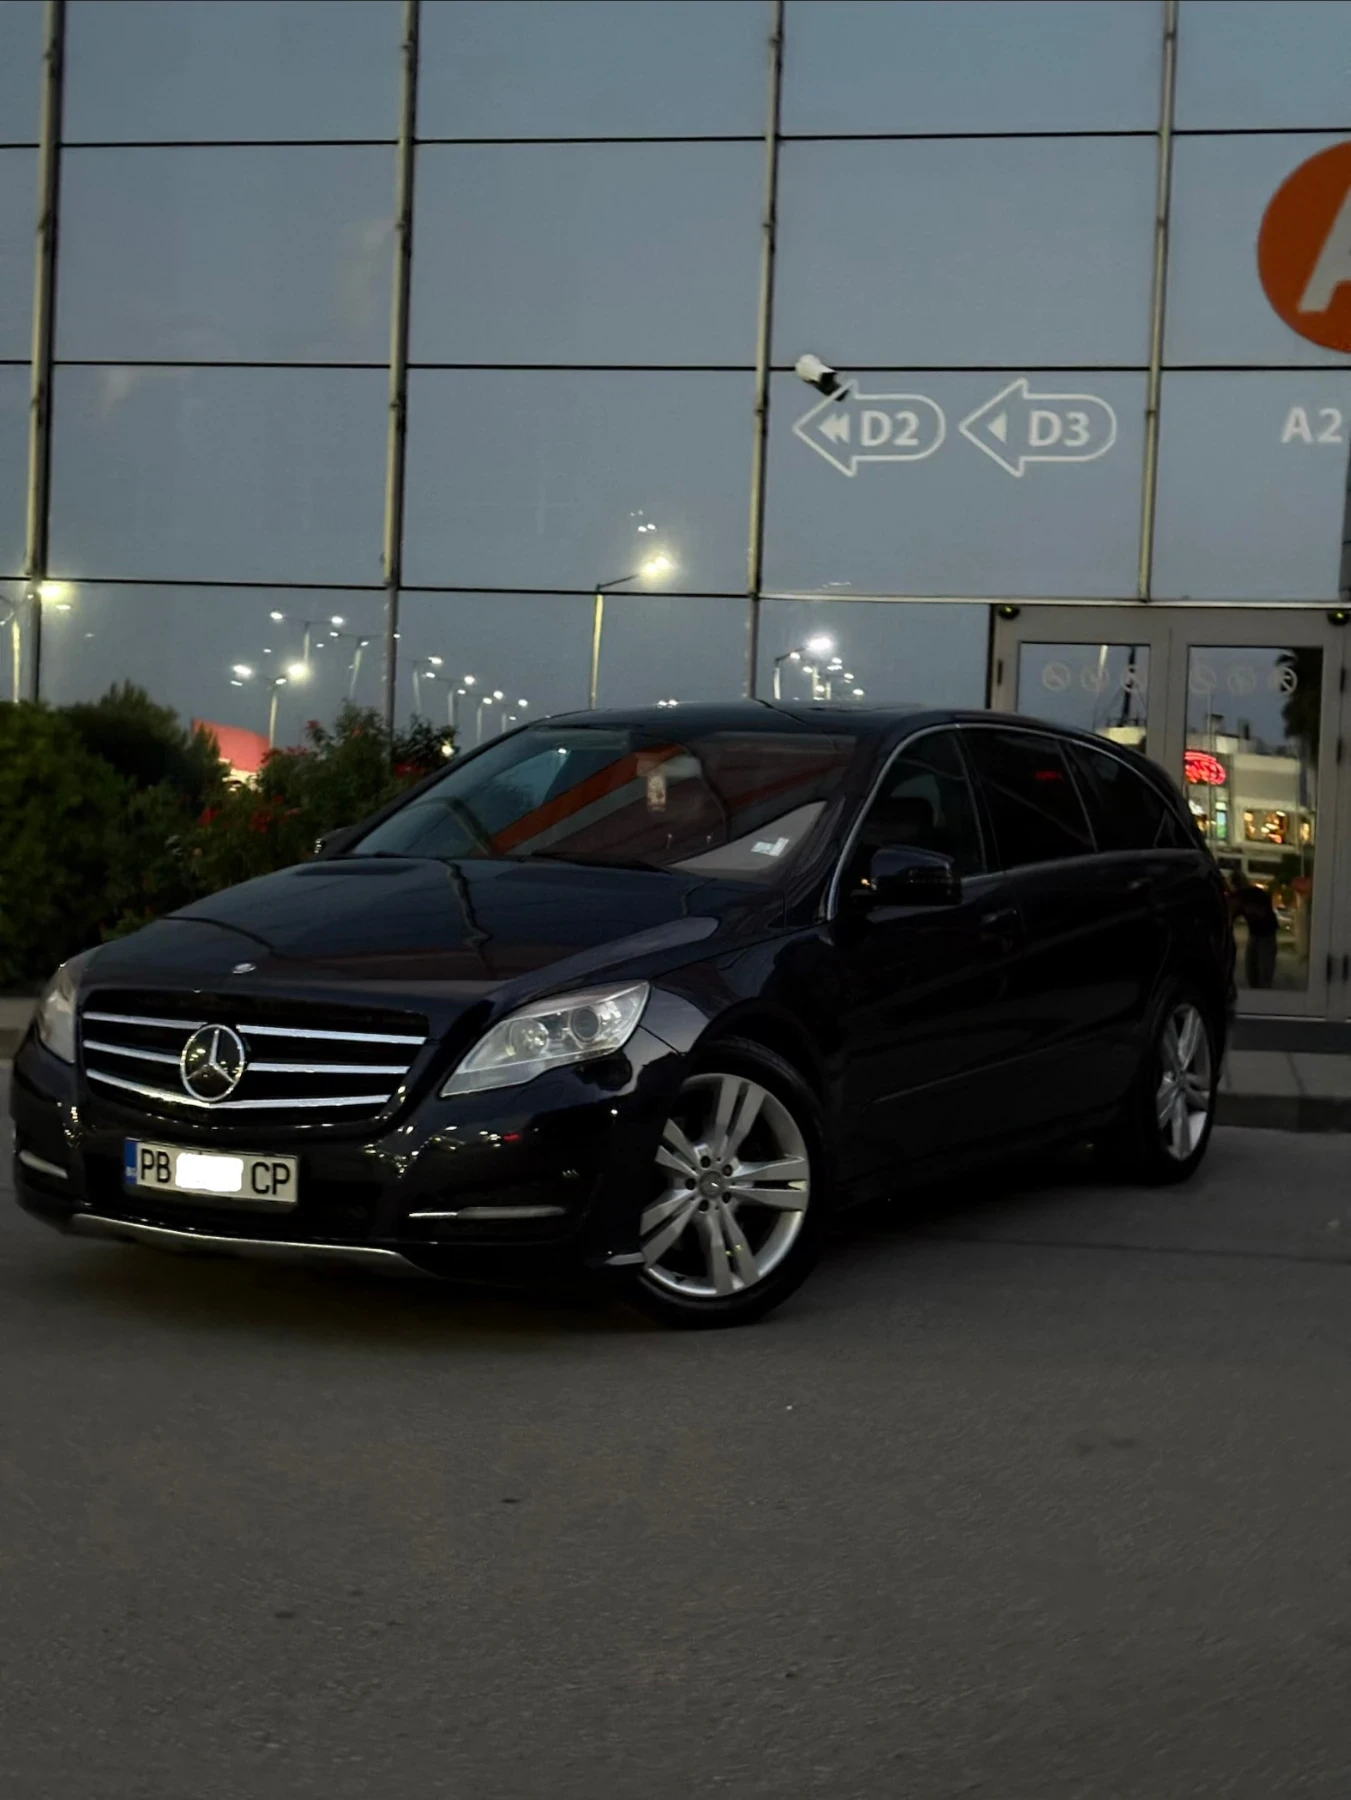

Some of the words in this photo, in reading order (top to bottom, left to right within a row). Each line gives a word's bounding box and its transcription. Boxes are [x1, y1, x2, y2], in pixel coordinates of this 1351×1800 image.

[861, 410, 919, 447] D2
[1028, 410, 1090, 447] D3
[1281, 407, 1343, 443] A2
[141, 1148, 171, 1183] PB
[252, 1161, 290, 1195] CP
